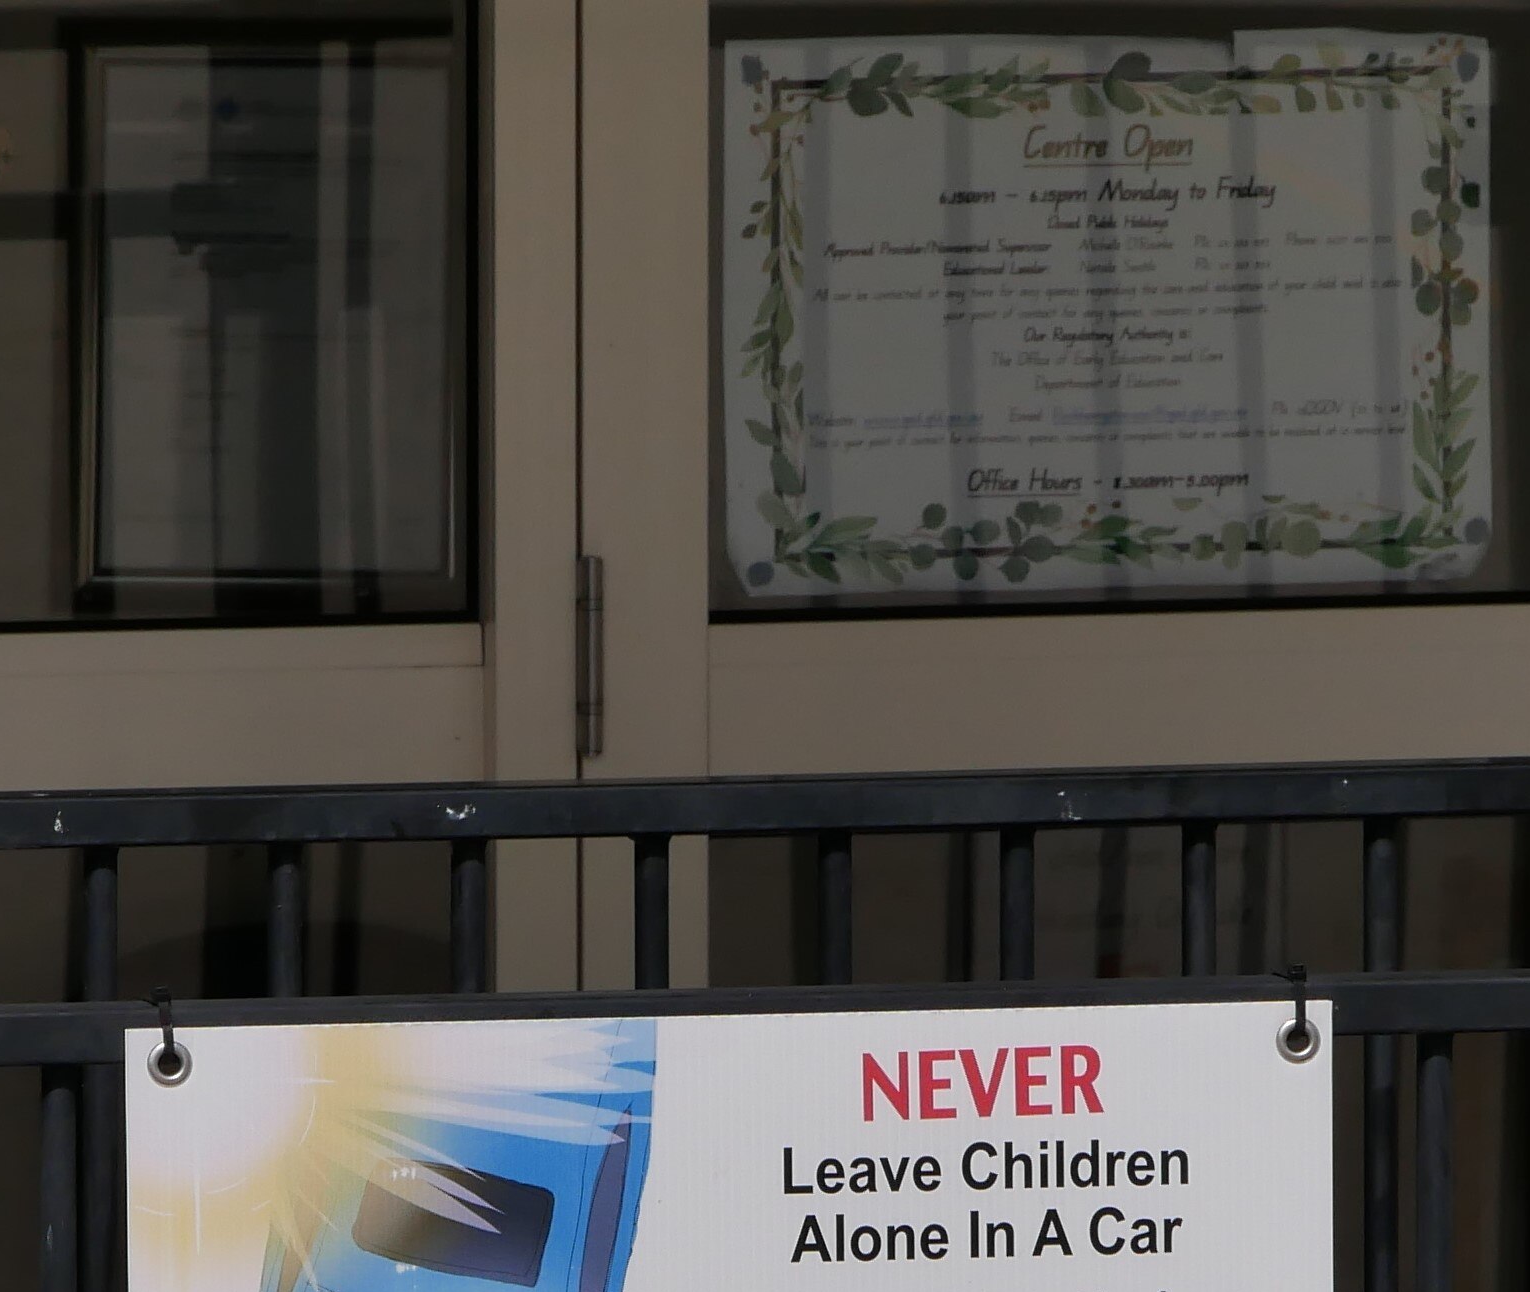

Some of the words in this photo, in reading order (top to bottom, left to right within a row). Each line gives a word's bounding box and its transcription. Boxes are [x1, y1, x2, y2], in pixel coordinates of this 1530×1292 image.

[1023, 124, 1109, 161] Centre
[1124, 123, 1193, 172] Open
[1097, 178, 1180, 211] Monday
[1190, 182, 1207, 200] to
[1216, 175, 1277, 209] Friday
[967, 467, 1018, 492] Office
[1028, 466, 1083, 492] Hours
[863, 1045, 1104, 1121] NEVER
[784, 1147, 941, 1194] Leave
[962, 1139, 1188, 1190] Children
[791, 1214, 949, 1263] Alone
[970, 1211, 1014, 1258] In
[1032, 1209, 1073, 1256] A
[1089, 1207, 1183, 1255] Car
